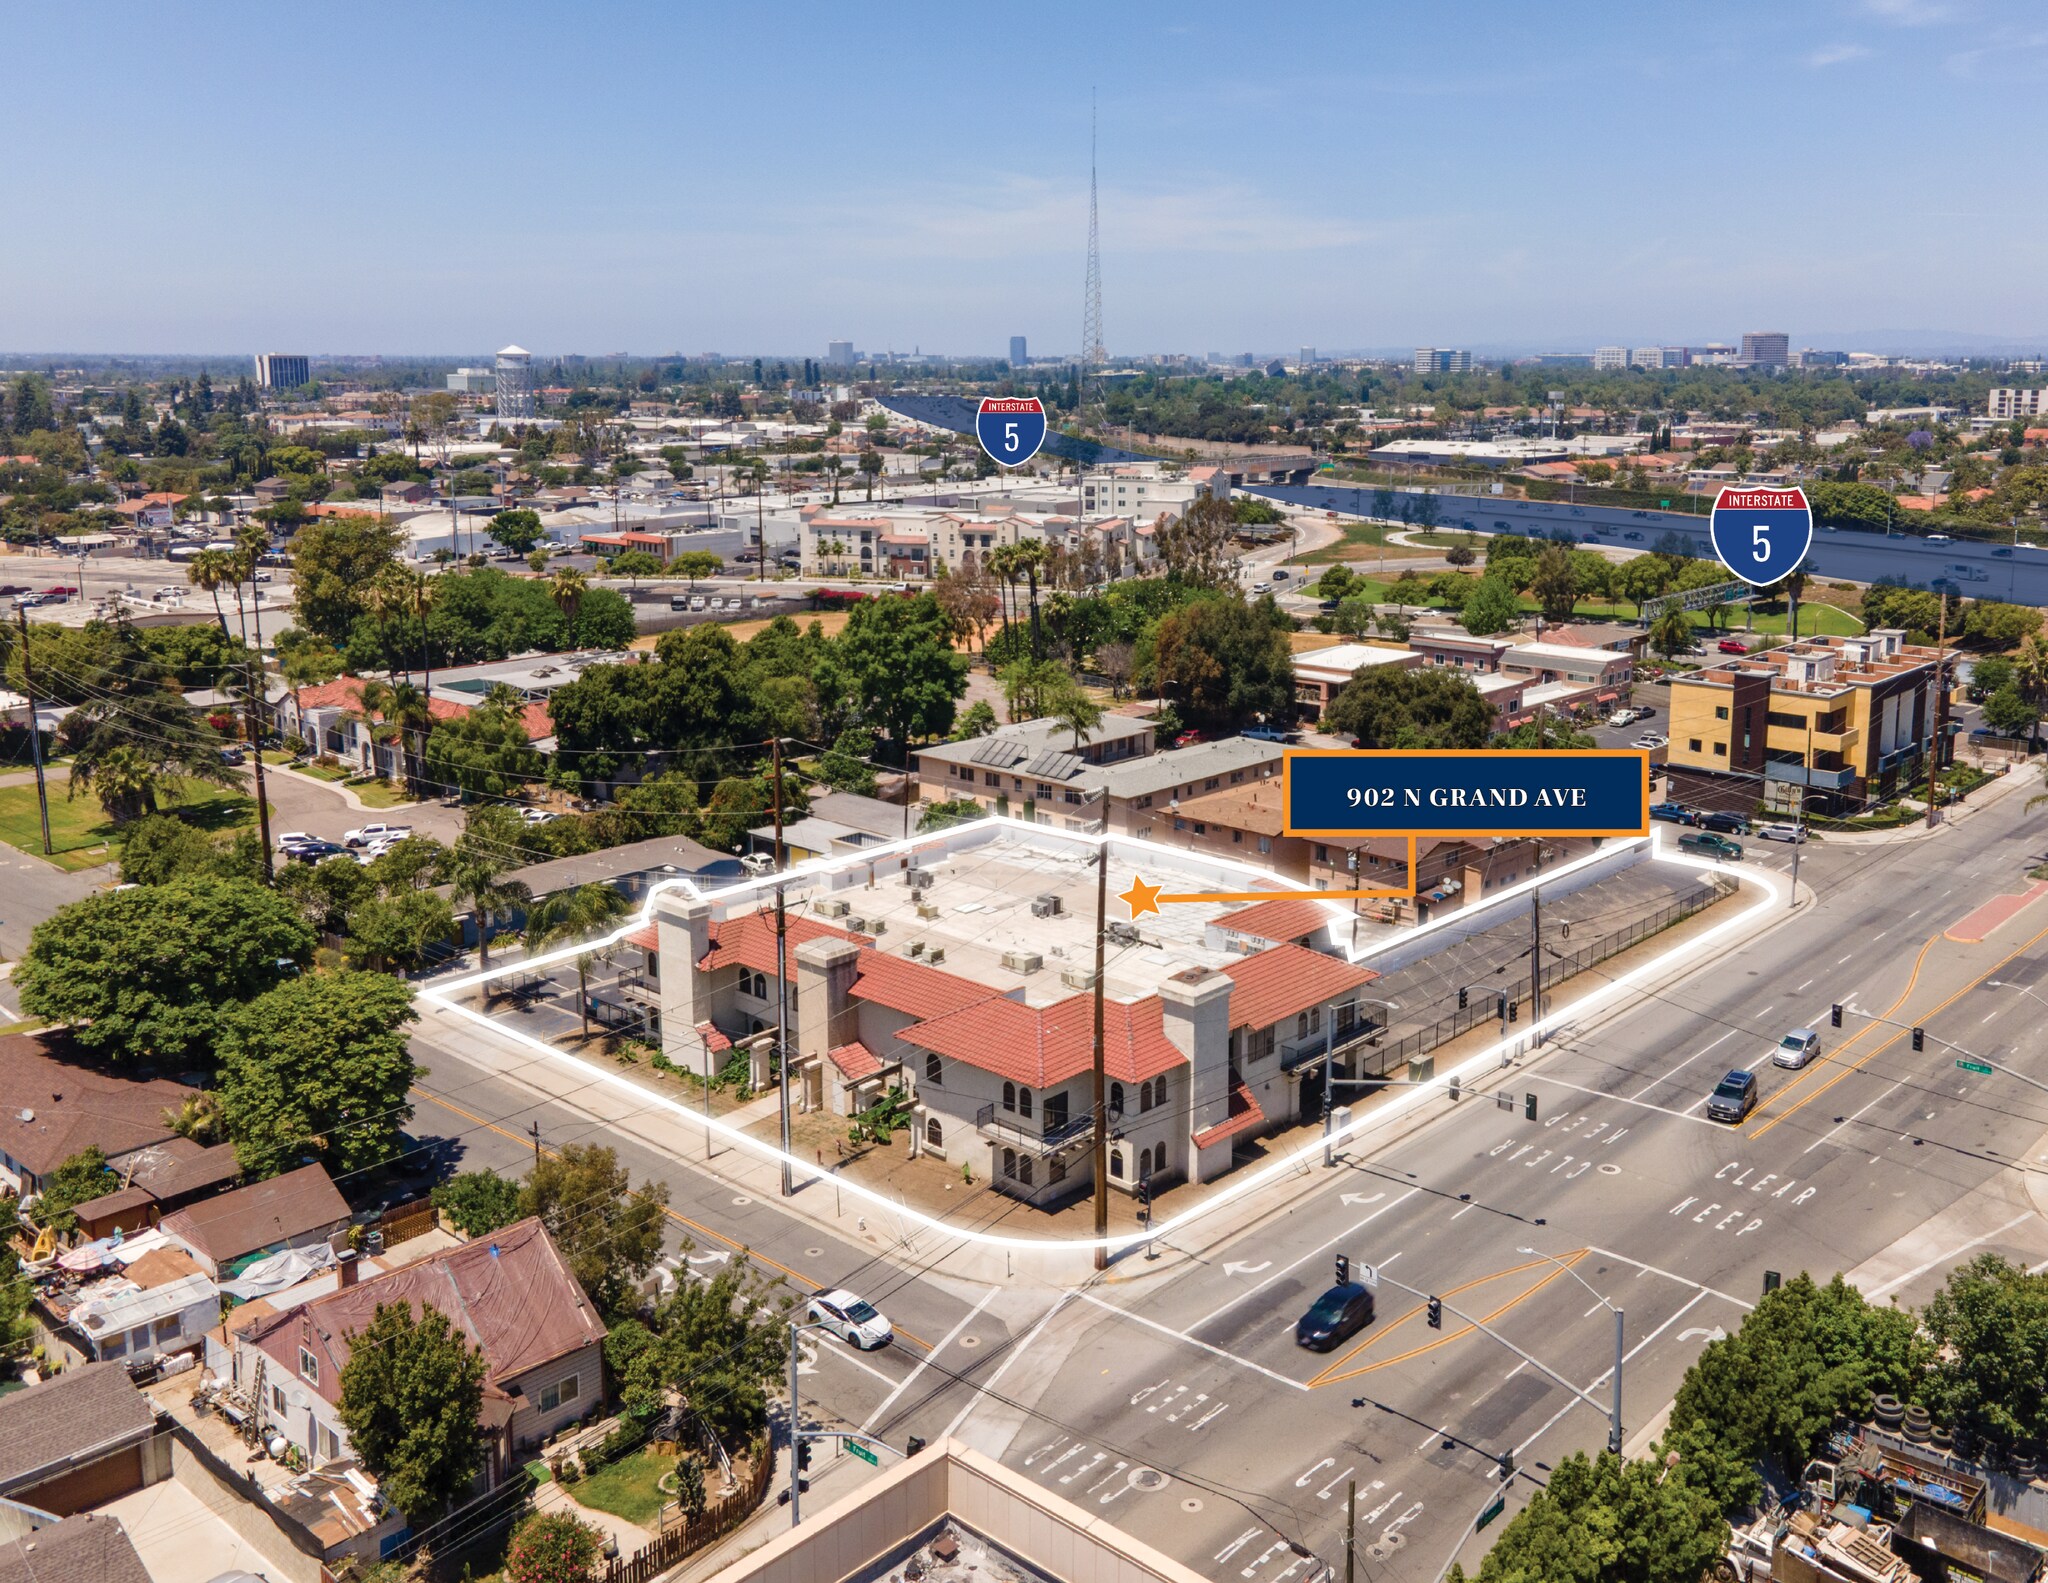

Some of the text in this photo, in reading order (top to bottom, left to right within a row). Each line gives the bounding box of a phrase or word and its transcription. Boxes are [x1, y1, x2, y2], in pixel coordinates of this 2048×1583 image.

[1544, 1111, 1629, 1145] KEEP
[1490, 1139, 1591, 1179] CLEAR
[1714, 1161, 1817, 1206] CLEAR
[1668, 1196, 1763, 1236] KEEP
[1131, 1379, 1229, 1432] KEEP
[1024, 1434, 1142, 1504] CLEAR
[1295, 1457, 1425, 1533] CLEAR
